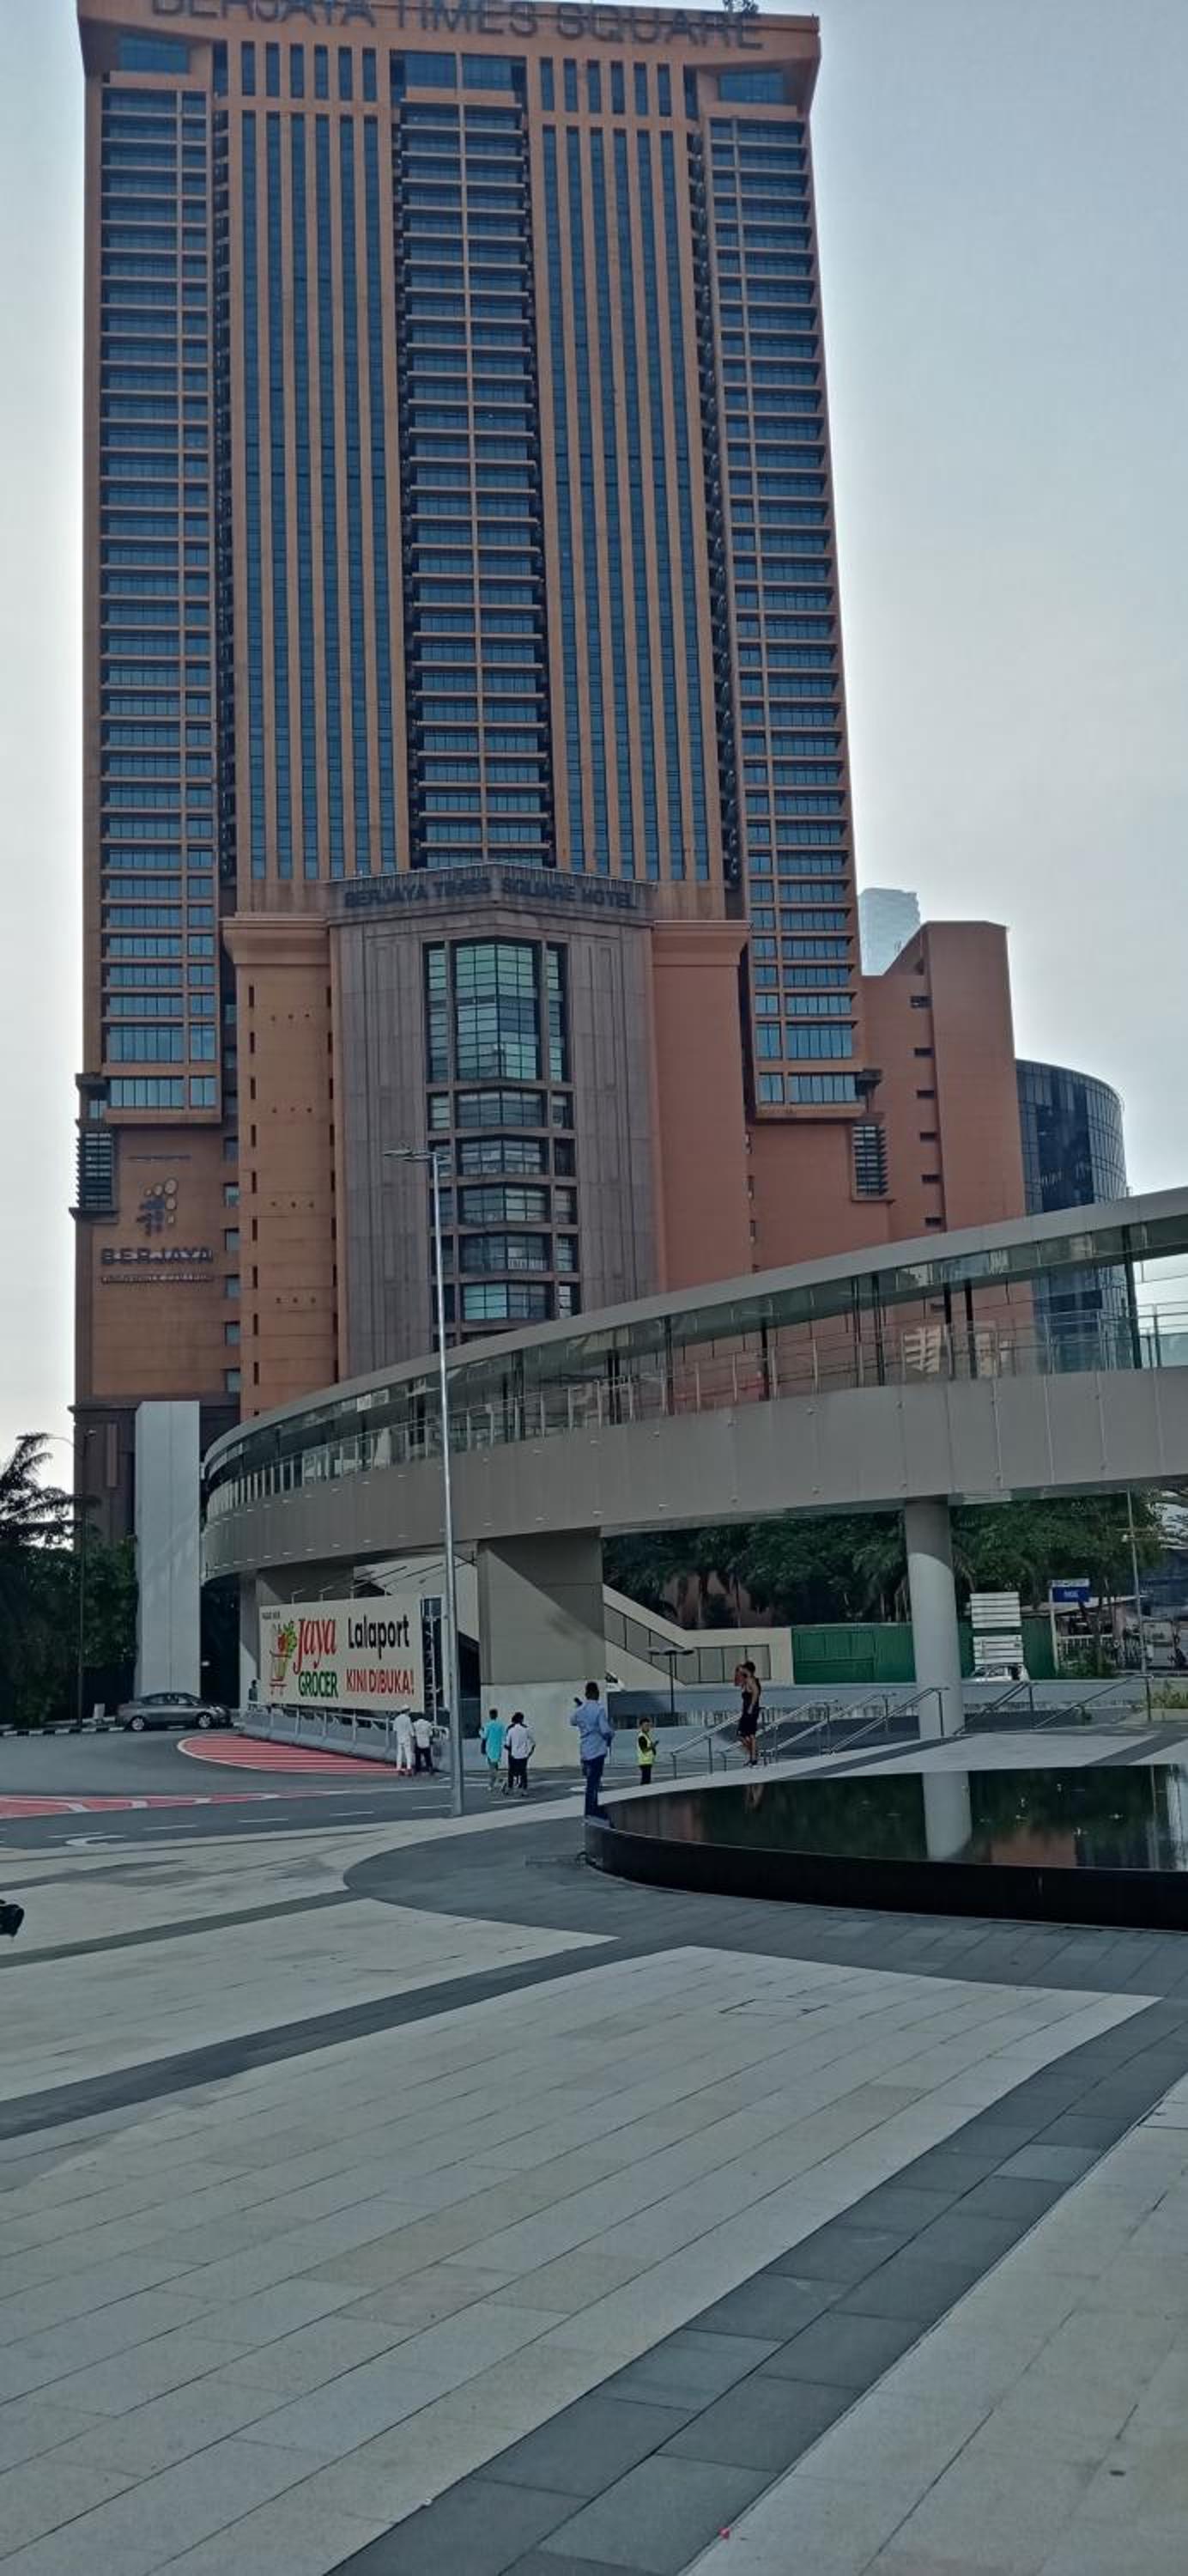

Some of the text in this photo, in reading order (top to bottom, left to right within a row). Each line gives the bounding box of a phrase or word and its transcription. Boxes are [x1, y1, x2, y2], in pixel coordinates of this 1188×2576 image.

[393, 0, 538, 38] TIMES
[557, 3, 764, 51] SQUARE
[344, 884, 427, 908] BERJAYA
[502, 877, 576, 902] SQUARE
[582, 888, 638, 910] HOTEL
[100, 1247, 214, 1266] BERJAYA
[293, 1618, 337, 1675] Jaya
[348, 1613, 410, 1660] Lalaport
[298, 1671, 339, 1698] GROCER
[347, 1668, 415, 1696] KINI DIBUKA!
